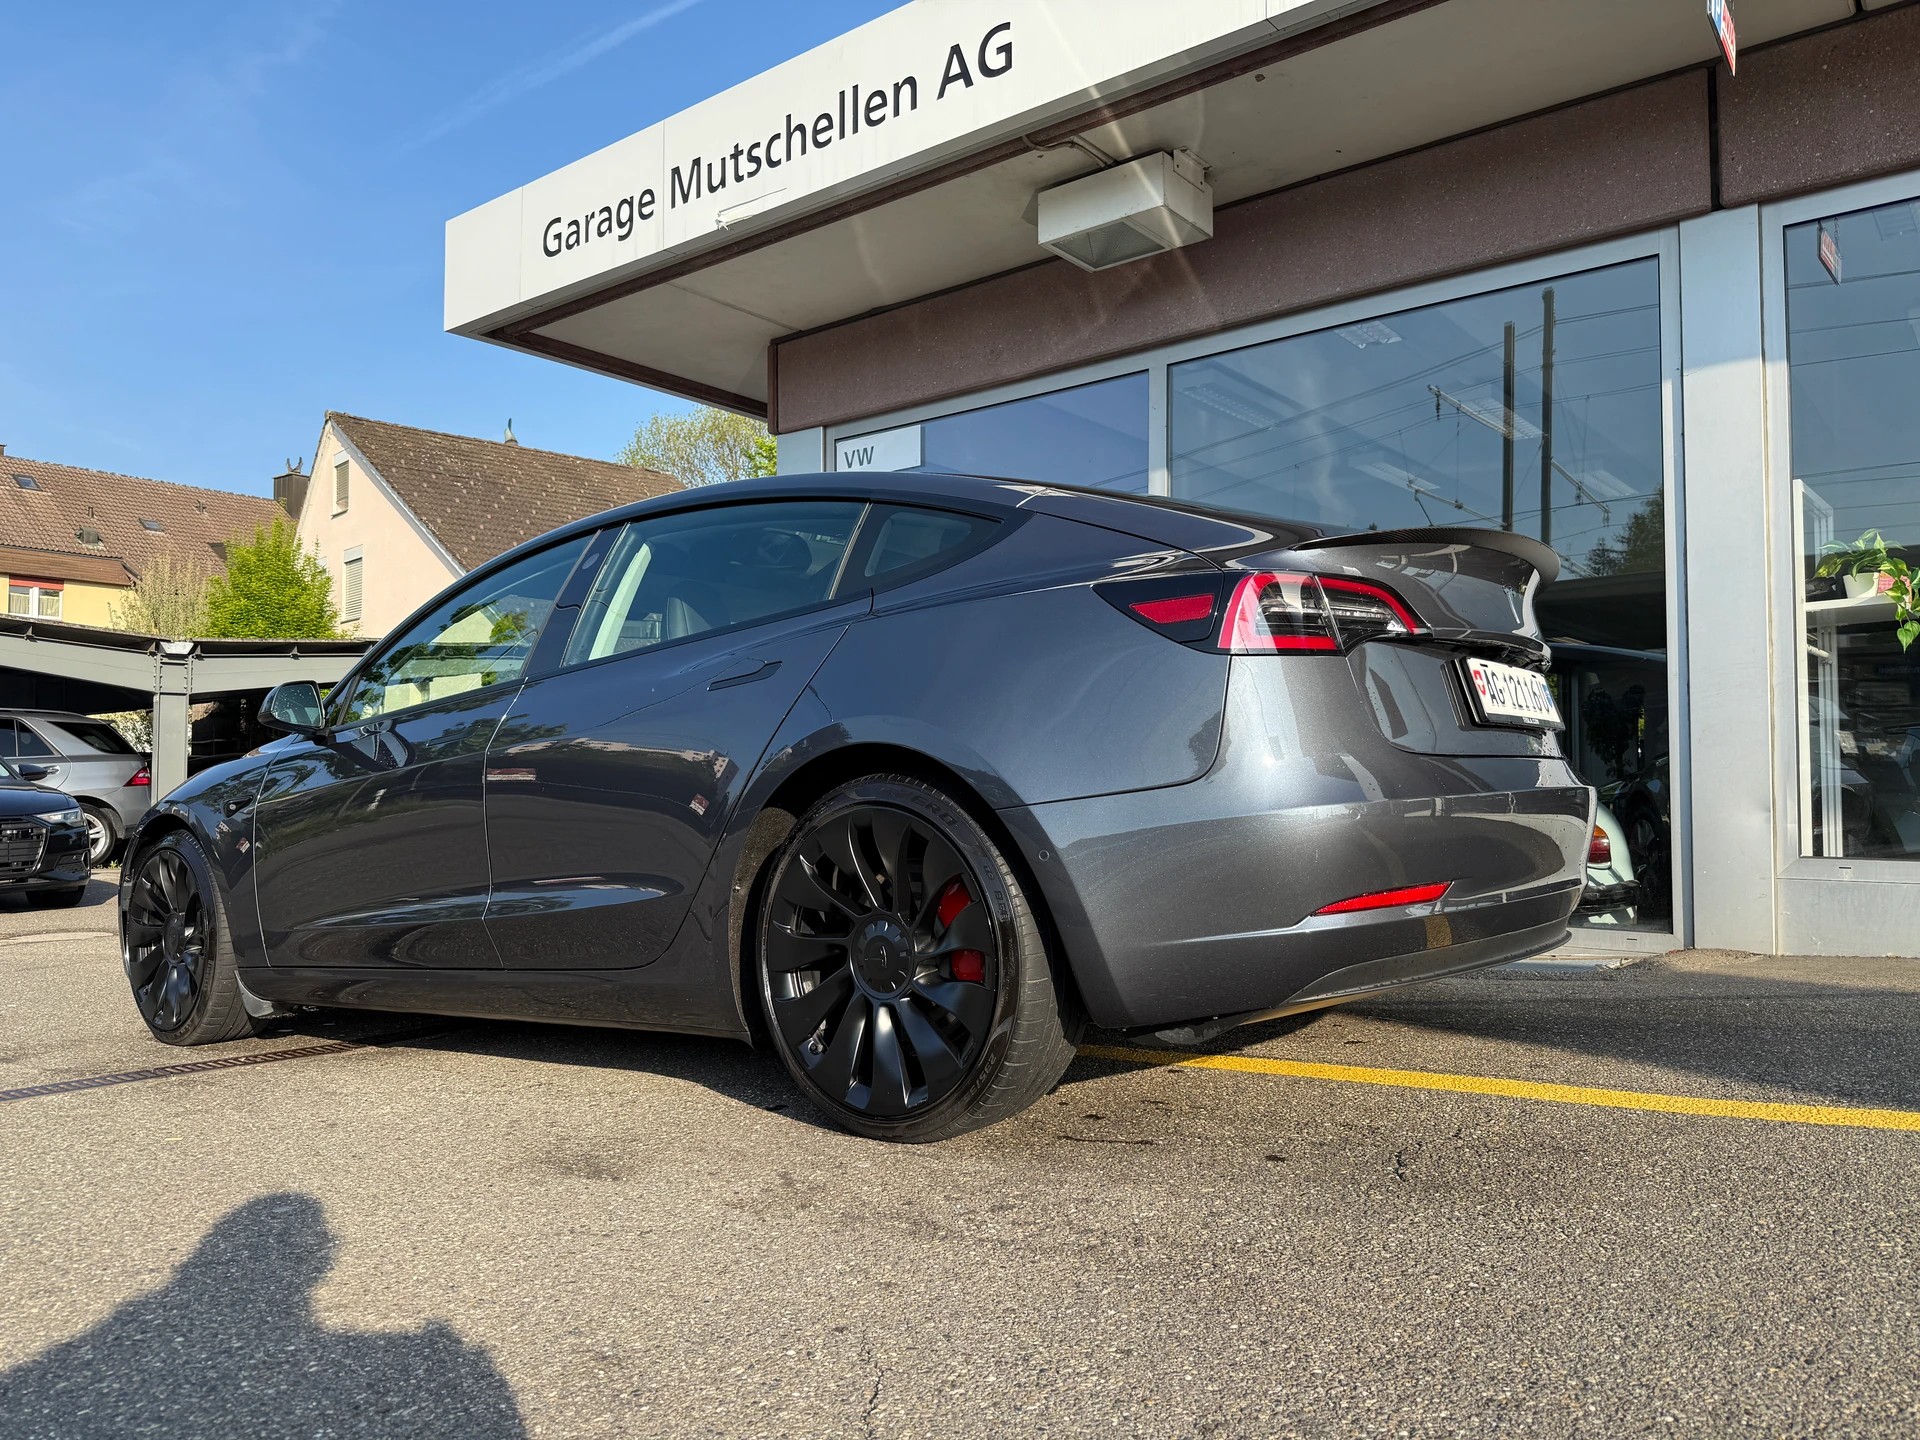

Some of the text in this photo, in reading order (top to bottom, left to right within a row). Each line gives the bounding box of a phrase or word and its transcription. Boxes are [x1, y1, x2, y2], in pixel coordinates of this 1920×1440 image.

[542, 21, 1013, 258] Garage Mutschellen AG
[844, 446, 875, 469] VW
